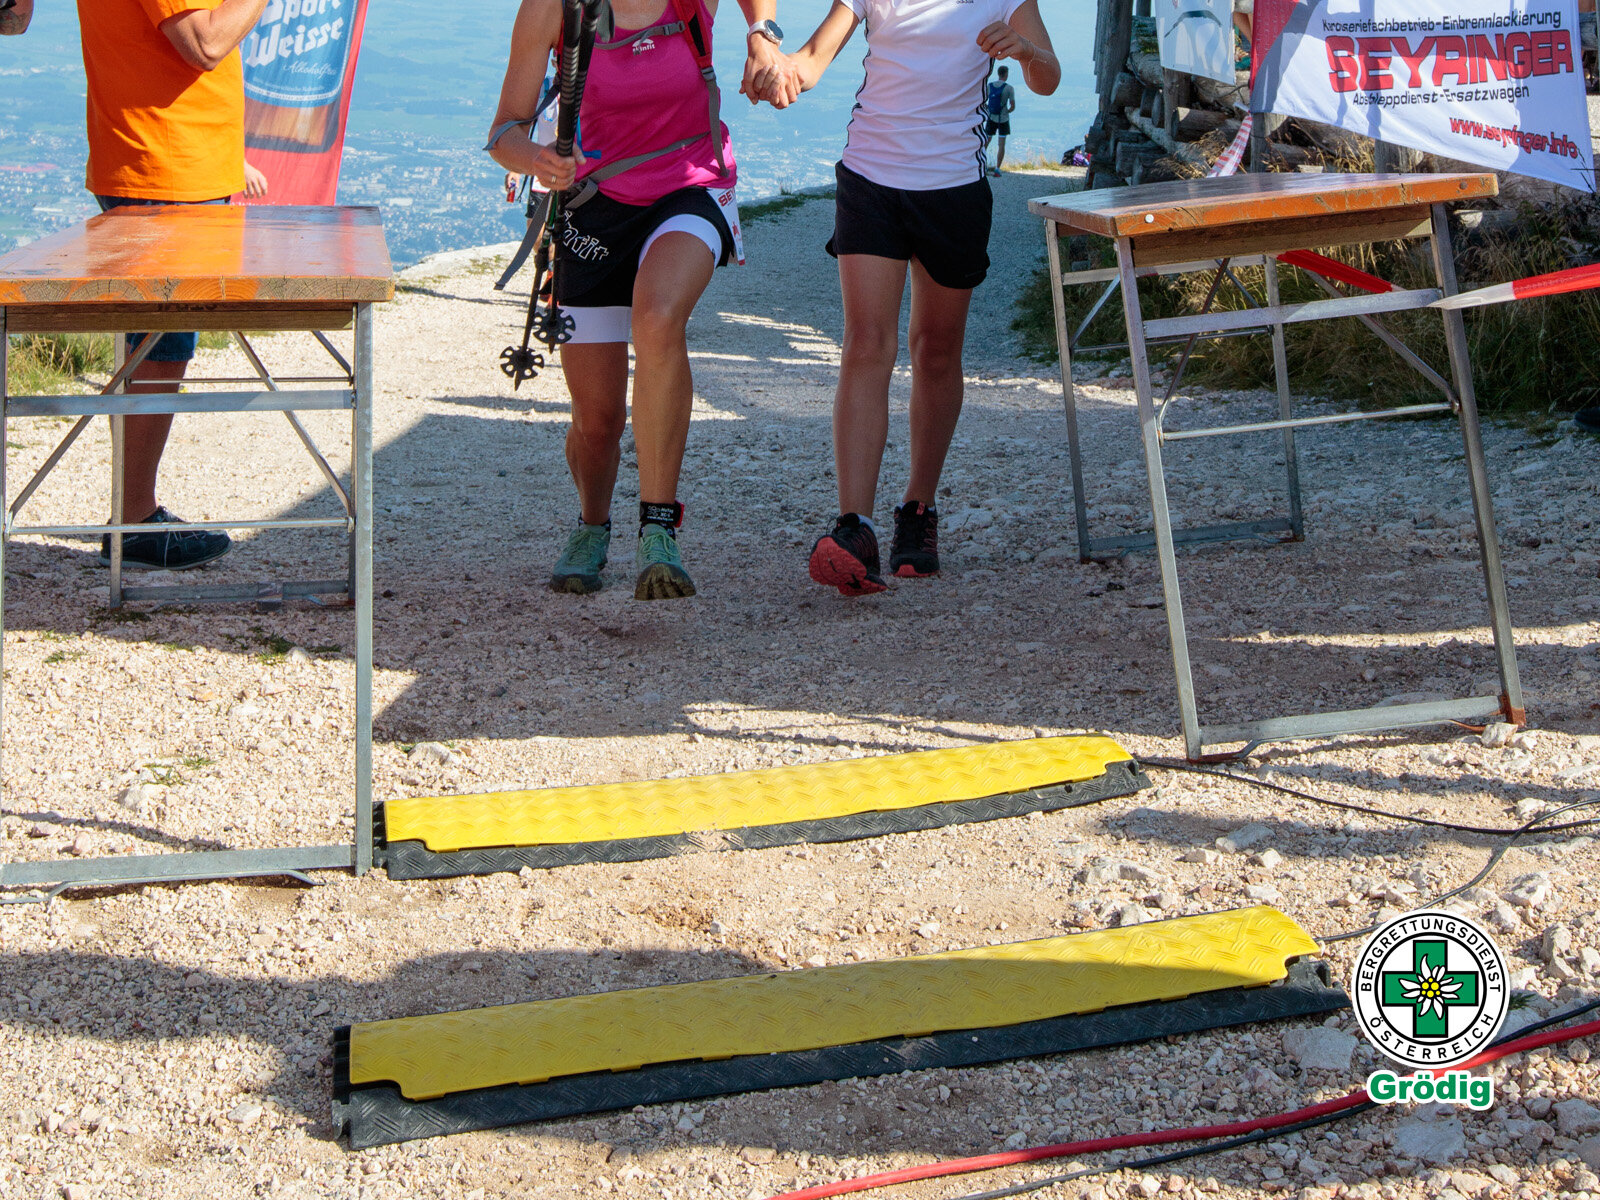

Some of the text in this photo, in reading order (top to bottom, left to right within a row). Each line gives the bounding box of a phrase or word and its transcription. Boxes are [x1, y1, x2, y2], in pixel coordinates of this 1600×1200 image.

[245, 16, 344, 68] Weisse
[1322, 11, 1561, 32] Kroseriefachbetrieb-Einbrennlackierung
[1325, 29, 1574, 93] SEYRINGER
[1449, 117, 1578, 159] www.seyringer.info
